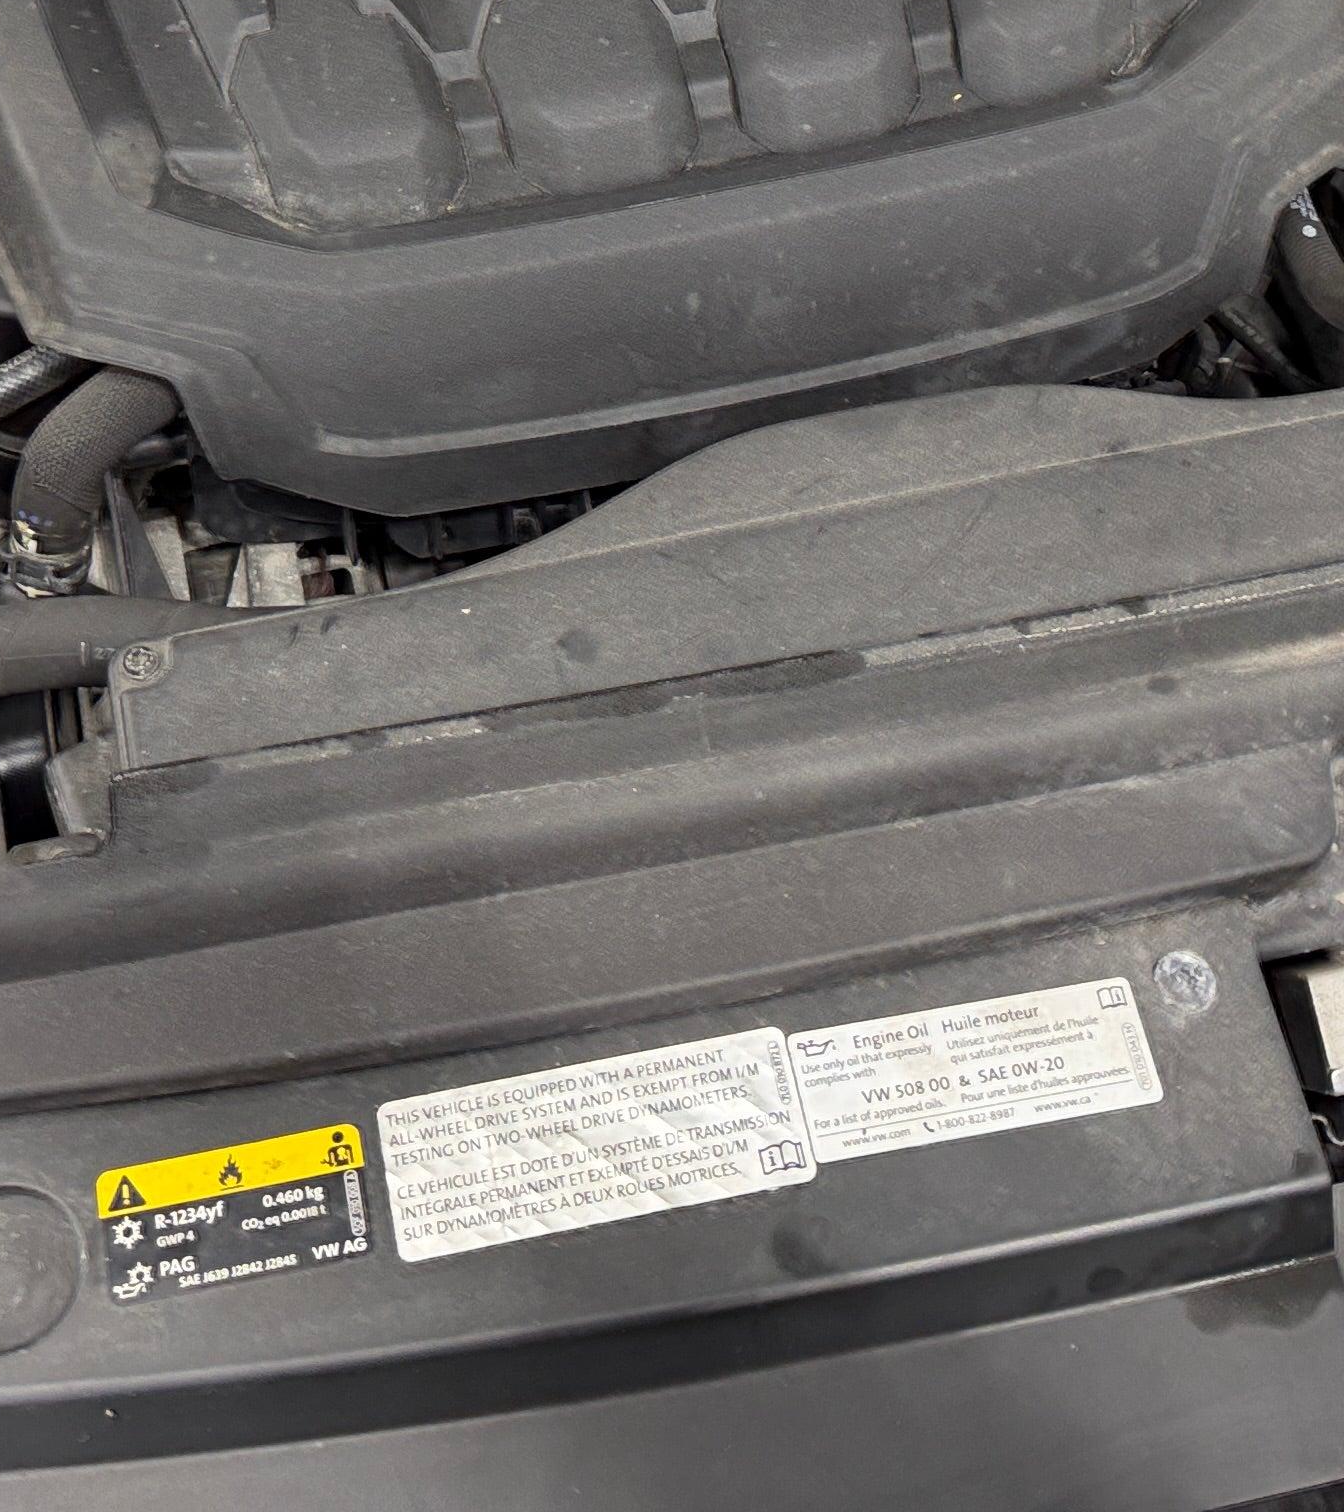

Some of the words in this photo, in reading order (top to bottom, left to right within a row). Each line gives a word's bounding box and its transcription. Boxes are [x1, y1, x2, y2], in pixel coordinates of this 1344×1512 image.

[940, 1013, 982, 1033] Huile
[983, 1003, 1041, 1026] moteur
[1051, 1020, 1066, 1031] de
[852, 1026, 906, 1052] Engine
[905, 1022, 928, 1039] Oil
[800, 1062, 821, 1075] Use
[822, 1057, 846, 1073] only
[845, 1054, 860, 1066] oil
[860, 1050, 883, 1064] that
[884, 1041, 933, 1063] expressly
[949, 1052, 968, 1065] qui
[385, 1109, 420, 1128] THIS
[421, 1096, 483, 1120] VEHICLE
[486, 1093, 500, 1107] IS
[503, 1078, 577, 1106] EQUIPPED
[579, 1069, 620, 1089] WITH
[622, 1067, 633, 1080] A
[635, 1048, 725, 1078] PERMANENT
[803, 1071, 851, 1090] complies
[851, 1065, 876, 1079] with
[861, 1086, 892, 1104] VW
[894, 1080, 925, 1098] 508
[927, 1075, 951, 1092] 00
[957, 1074, 971, 1086] &
[977, 1065, 1009, 1084] SAE
[1010, 1055, 1065, 1078] 0W-20
[388, 1119, 472, 1147] ALL-WHEEL
[474, 1109, 518, 1130] DRIVE
[521, 1098, 576, 1120] SYSTEM
[578, 1090, 613, 1109] AND
[616, 1087, 630, 1101] IS
[633, 1075, 688, 1098] EXEMPT
[691, 1067, 731, 1087] FROM
[960, 1089, 984, 1104] Pour
[985, 1087, 1006, 1099] une
[813, 1117, 832, 1130] For
[832, 1117, 840, 1126] a
[841, 1112, 859, 1124] list
[859, 1109, 872, 1121] of
[872, 1100, 923, 1121] approved
[392, 1142, 454, 1167] TESTING
[457, 1137, 481, 1154] ON
[485, 1118, 577, 1148] TWO-WHEEL
[580, 1108, 625, 1129] DRIVE
[842, 1127, 911, 1148] www.vw.com
[396, 1184, 416, 1200] CE
[491, 1163, 518, 1180] EST
[664, 1131, 684, 1146] DE
[479, 1174, 566, 1204] PERMANENT
[568, 1171, 585, 1186] ET
[651, 1145, 710, 1170] D'ESSAIS
[262, 1187, 303, 1209] 0.460
[304, 1181, 324, 1204] kg
[402, 1223, 433, 1241] SUR
[572, 1185, 618, 1206] DEUX
[616, 1176, 665, 1198] ROUES
[154, 1200, 225, 1232] R-1234yf
[264, 1214, 280, 1228] eq
[319, 1203, 327, 1215] t
[155, 1231, 185, 1249] GWP
[185, 1229, 195, 1242] 4
[311, 1241, 339, 1261] VW
[342, 1235, 368, 1255] AG
[158, 1254, 195, 1278] PAG
[178, 1272, 201, 1288] SAE
